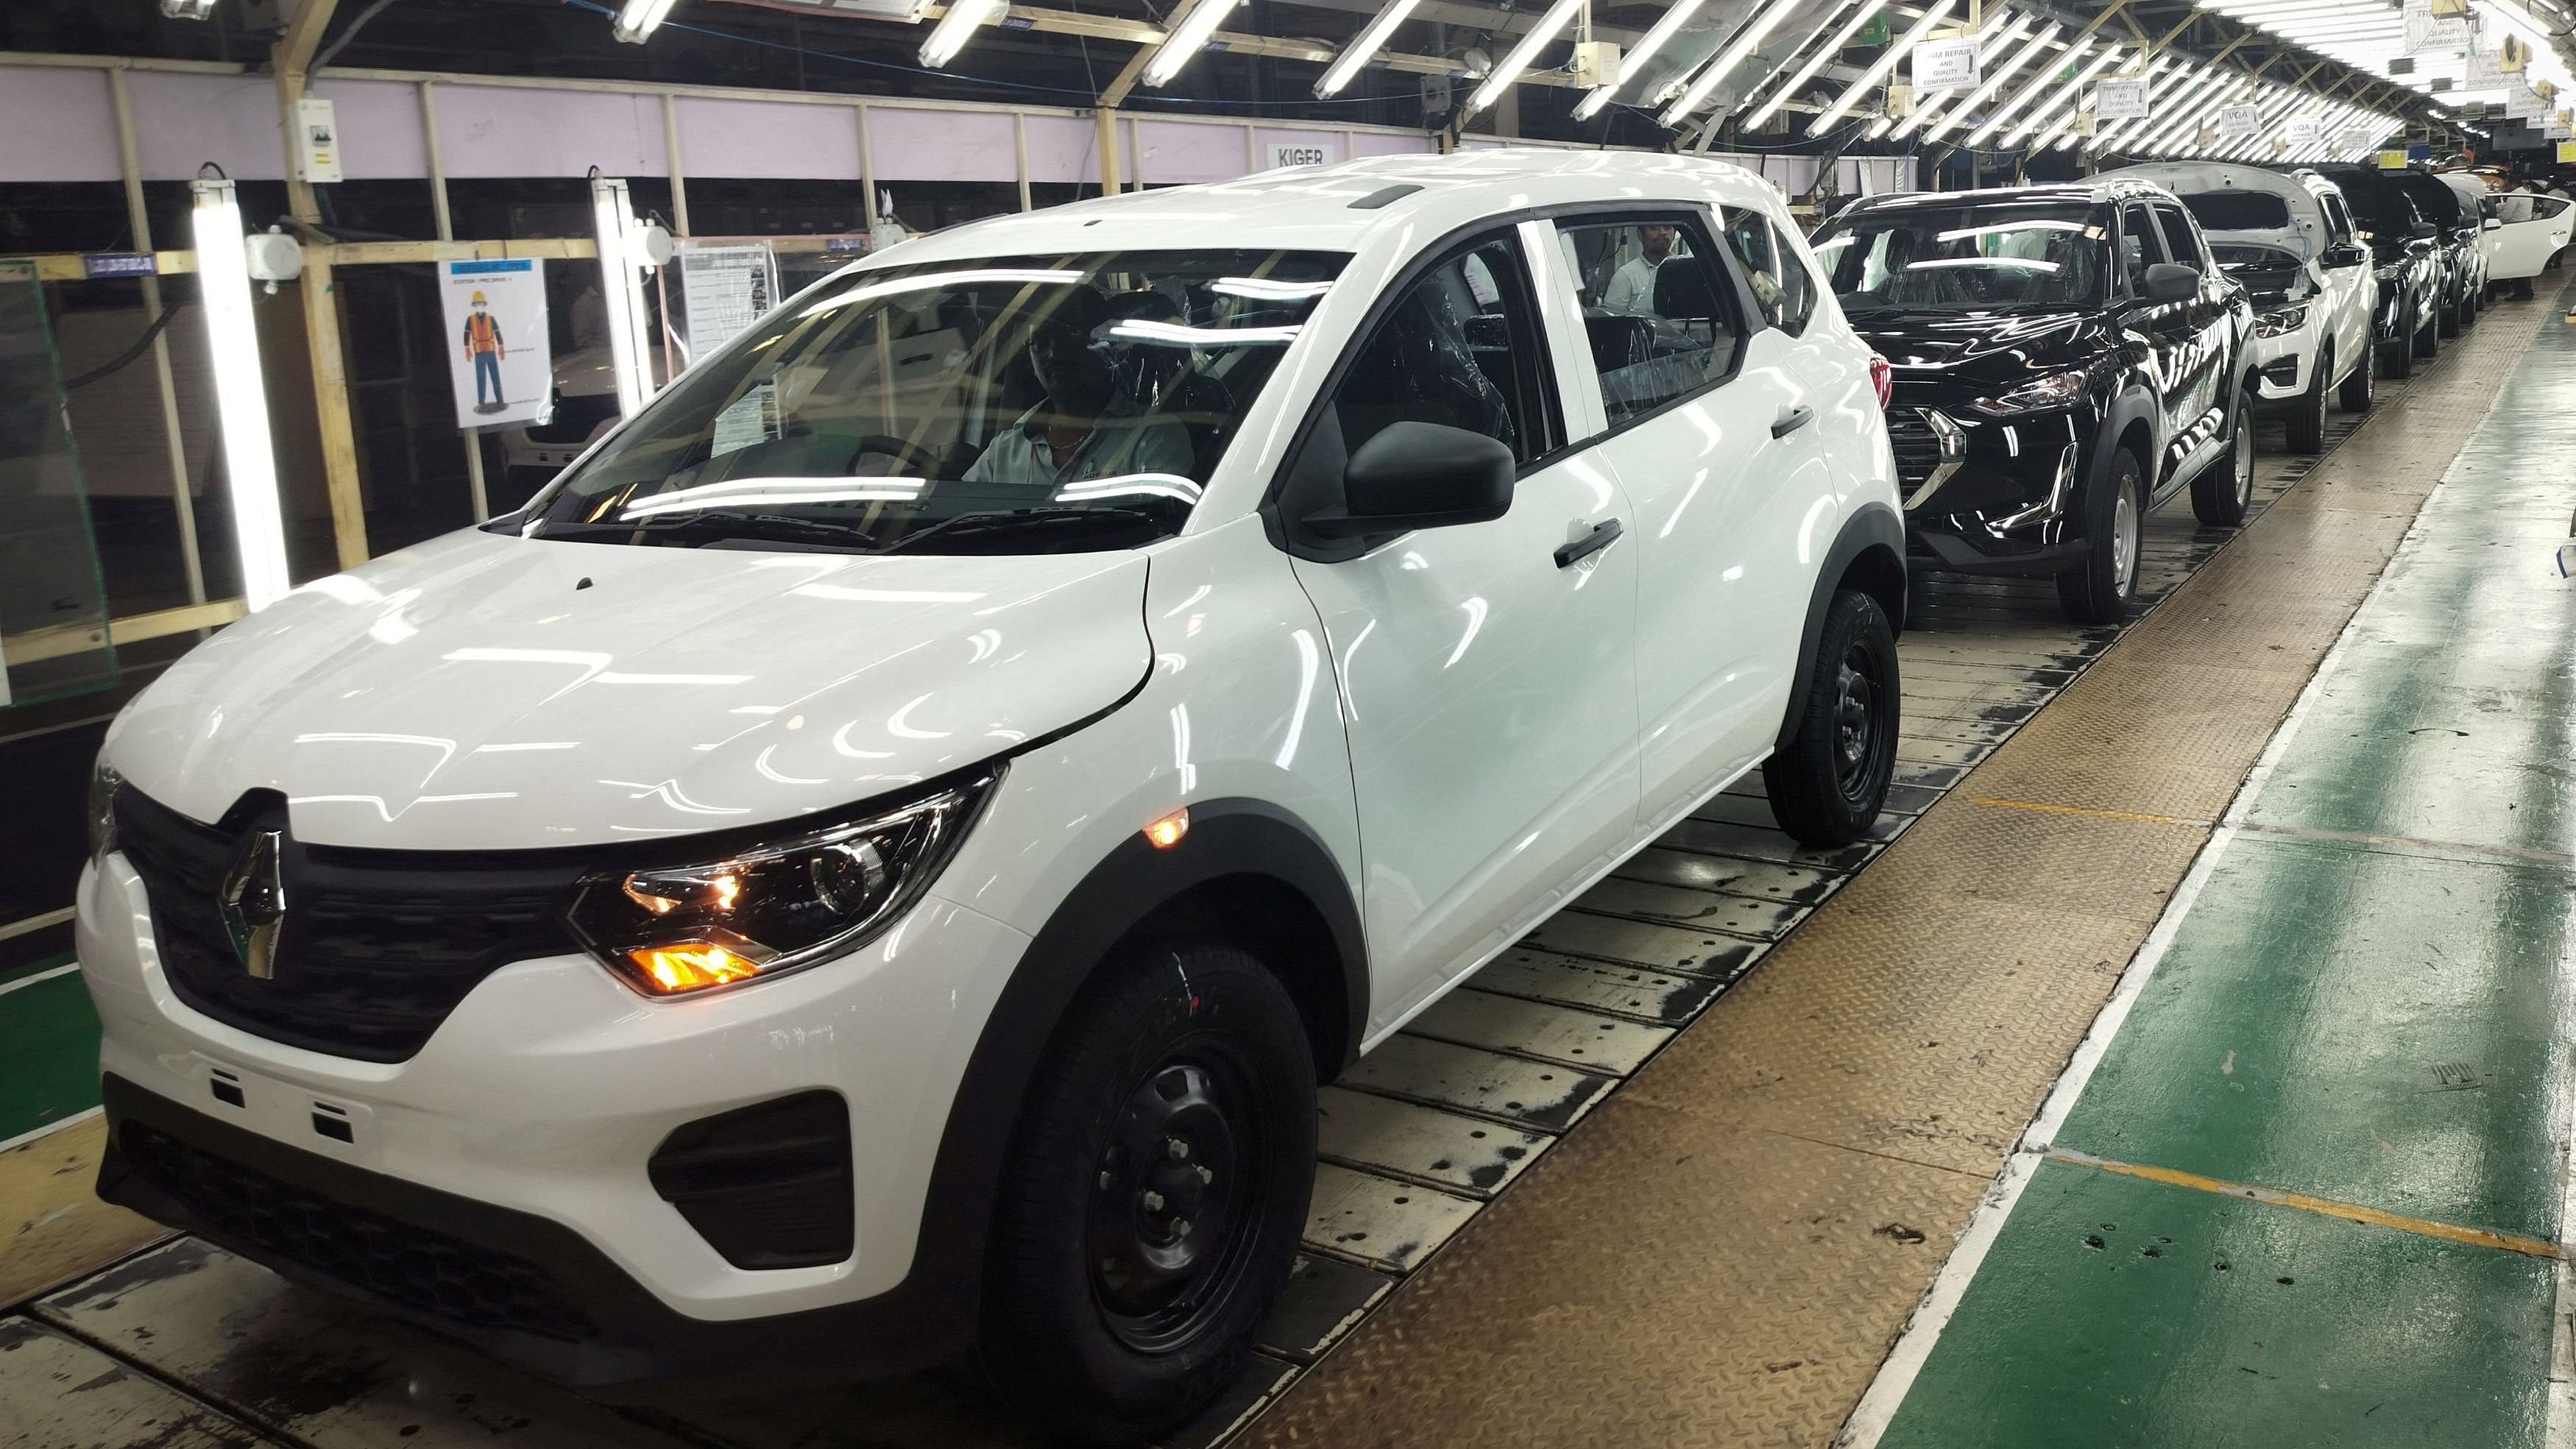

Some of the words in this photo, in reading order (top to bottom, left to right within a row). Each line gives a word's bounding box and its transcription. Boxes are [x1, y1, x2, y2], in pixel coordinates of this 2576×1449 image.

[2429, 28, 2461, 37] QUALITY
[1945, 49, 1973, 58] REPAIR
[1933, 68, 1958, 77] QUALITY
[1923, 76, 1969, 86] CONFIRMATION
[2229, 110, 2248, 119] VQA
[1278, 149, 1323, 167] KIGER
